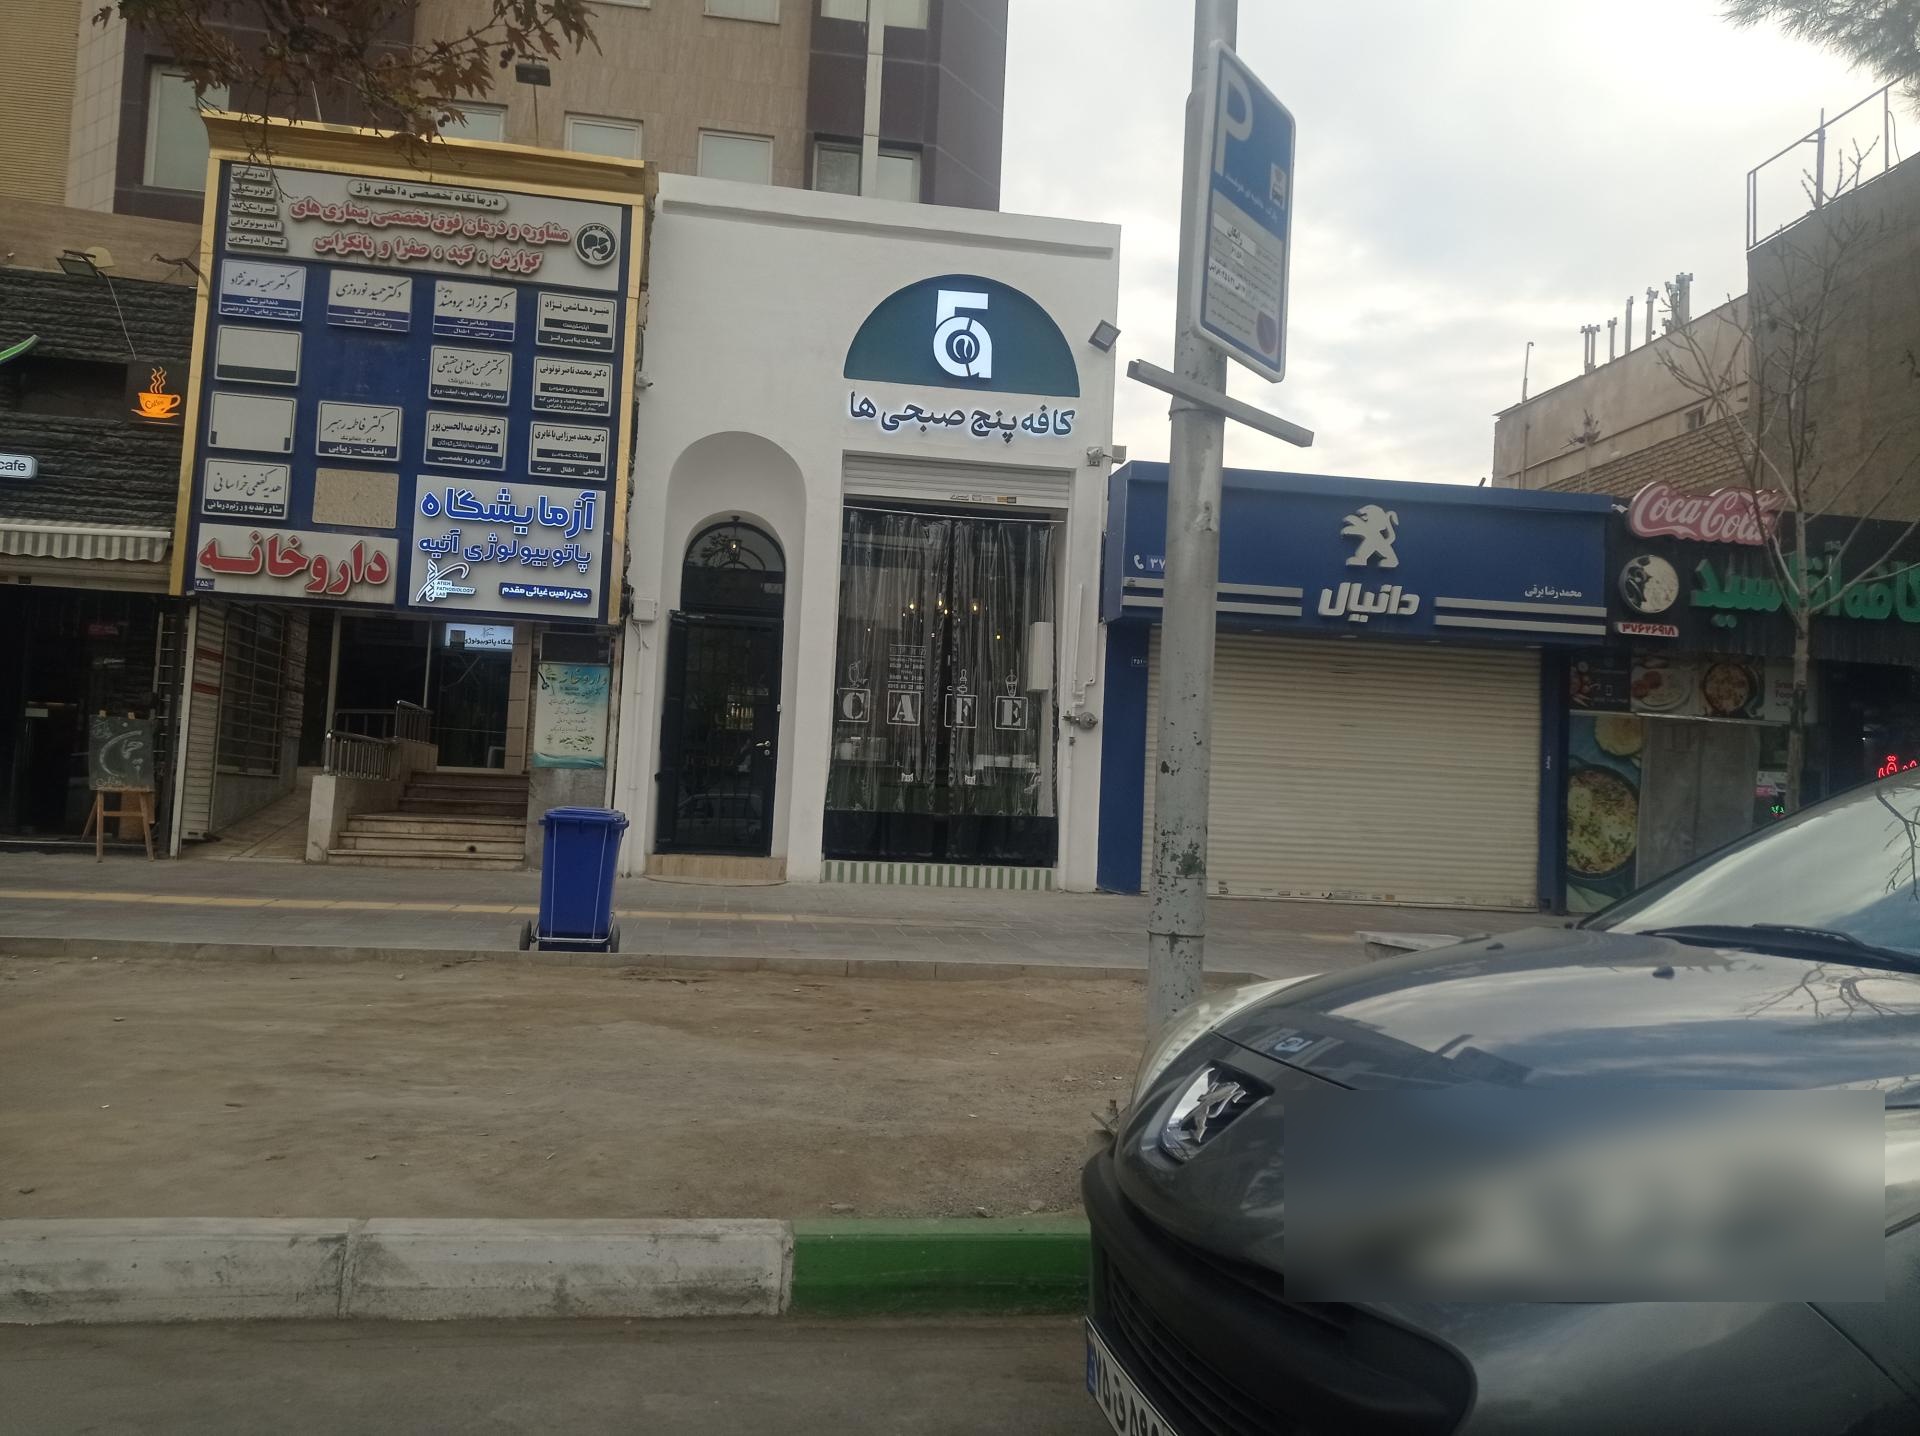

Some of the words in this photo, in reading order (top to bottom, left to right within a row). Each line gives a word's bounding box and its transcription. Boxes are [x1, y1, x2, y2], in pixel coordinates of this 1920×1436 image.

[1214, 52, 1253, 176] P
[374, 184, 406, 196] داخلی
[409, 190, 452, 201] تخصصی
[290, 196, 322, 219] های
[454, 193, 499, 207] درمانگاه
[321, 199, 371, 222] بیماری
[372, 208, 431, 227] تخصصی
[430, 211, 463, 234] فوق
[462, 215, 506, 238] درمان
[506, 222, 520, 241] و
[520, 223, 571, 245] مشاوره
[314, 231, 376, 258] پانکراس
[376, 240, 392, 259] و
[392, 235, 430, 260] صفرا
[446, 244, 476, 266] کبد
[489, 249, 544, 274] گوارش
[272, 270, 299, 291] دکتر
[336, 282, 369, 297] نوروزی
[368, 287, 387, 301] حمید
[382, 279, 410, 303] دکتر
[467, 294, 488, 313] فرزانه
[488, 291, 515, 313] دکتر
[472, 360, 491, 376] محسن
[485, 358, 506, 377] دکتر
[560, 366, 575, 376] ناصر
[575, 367, 592, 376] محمد
[592, 369, 607, 379] دکتر
[849, 391, 877, 418] ها
[346, 416, 366, 431] فاطمه
[363, 410, 396, 435] دکتر
[880, 403, 967, 433] صبحی
[970, 408, 1018, 444] پنج
[1021, 404, 1076, 436] کافه
[487, 424, 502, 436] دکتر
[576, 432, 593, 441] محمد
[592, 433, 606, 444] دکتر
[327, 443, 353, 455] زیبایی
[361, 446, 388, 457] ایمپلنت
[536, 464, 552, 473] پوست
[560, 465, 576, 474] اطفال
[583, 468, 600, 476] داخلی
[420, 487, 597, 539] آزمایشگاه
[1632, 484, 1777, 542] Coca-Cola
[418, 528, 461, 559] آتیه
[463, 532, 592, 573] پاتوبیولوژی
[197, 530, 391, 595] داروخانه
[501, 585, 526, 597] مقدم
[548, 588, 569, 600] رامین
[567, 588, 588, 600] دکتر
[1318, 581, 1421, 623] دانیال
